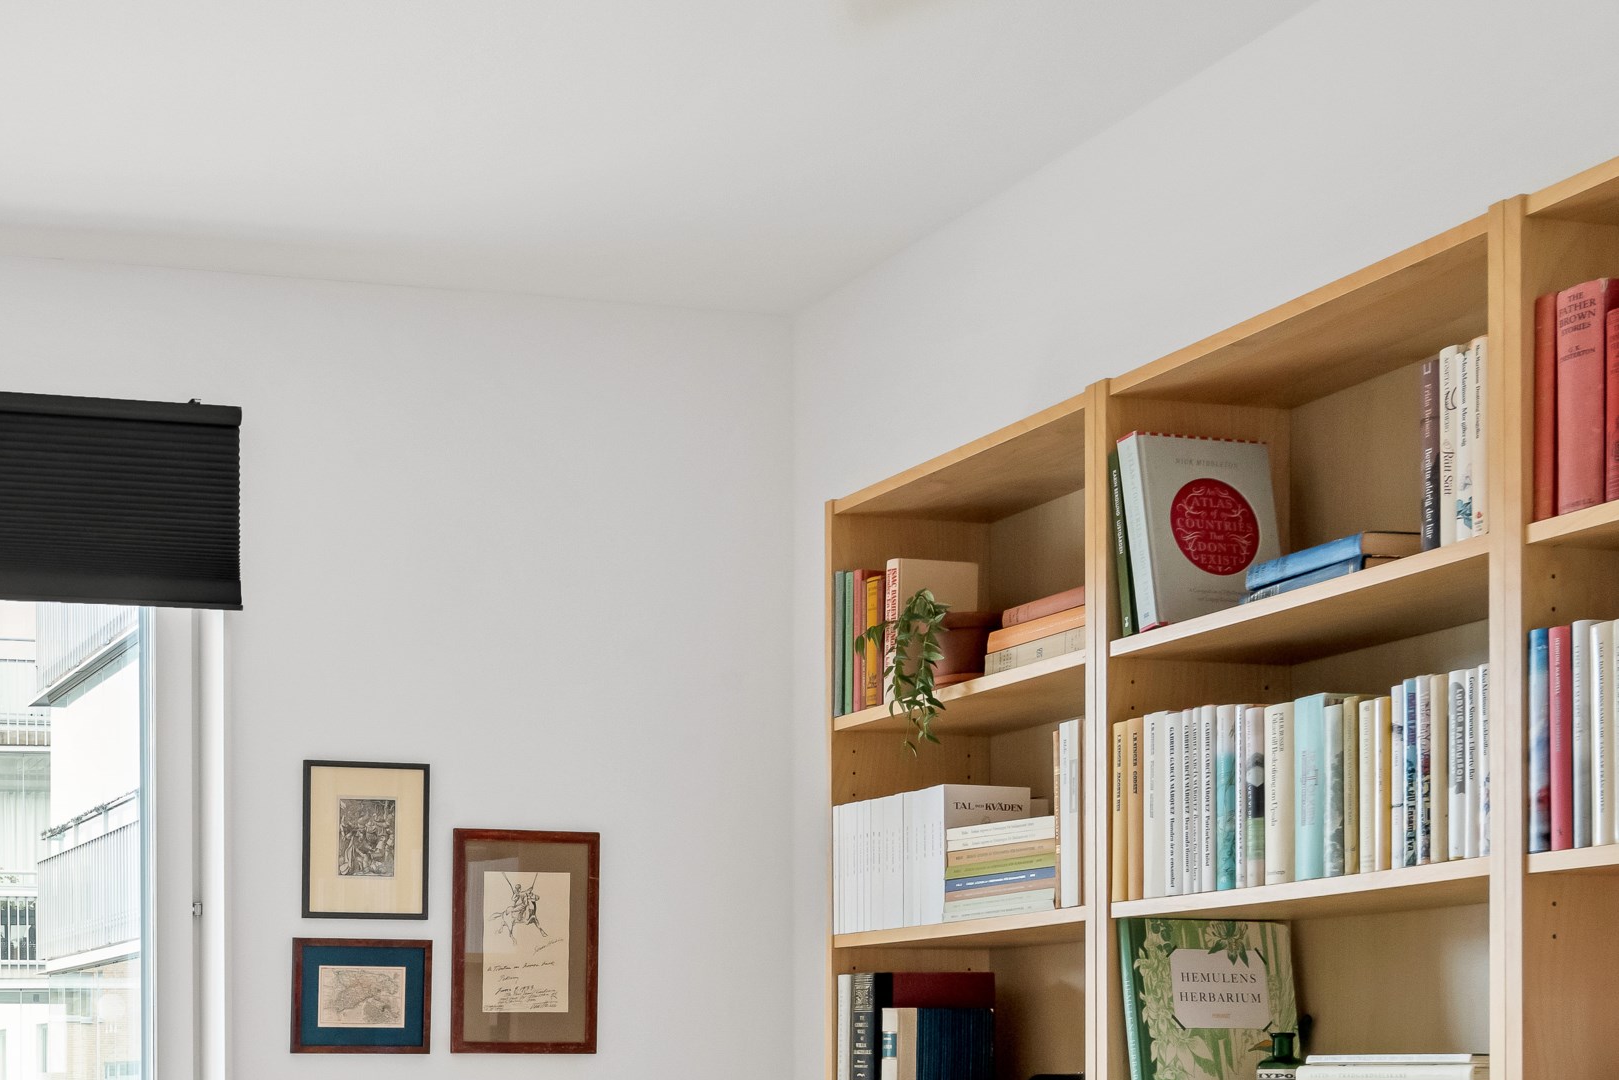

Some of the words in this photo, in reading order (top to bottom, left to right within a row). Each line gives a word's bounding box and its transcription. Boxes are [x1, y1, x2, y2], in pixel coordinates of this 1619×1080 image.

[1568, 291, 1584, 302] THE
[1559, 309, 1596, 328] BROWN
[1423, 447, 1433, 480] Berätta
[1442, 450, 1456, 473] Rätt
[1423, 480, 1433, 508] aldrig
[1442, 473, 1456, 496] Sätt
[1191, 497, 1232, 509] ATLAS
[1177, 517, 1254, 533] COUNTRIES
[1423, 508, 1433, 522] det
[1423, 522, 1433, 540] här
[1199, 542, 1239, 553] DON'T
[1200, 555, 1239, 565] EXIST
[1468, 676, 1477, 706] Georges
[1468, 705, 1477, 740] Simenon
[1168, 726, 1176, 757] GABRIEL
[1204, 721, 1212, 753] GABRIEL
[1468, 740, 1477, 768] Liberty
[1168, 756, 1176, 782] GARCÍA
[1204, 752, 1212, 779] GARCÍA
[1468, 768, 1477, 781] Bar
[1168, 782, 1176, 816] MÁRQUEZ
[1204, 780, 1212, 813] MÁRQUEZ
[1406, 789, 1417, 802] till
[953, 801, 973, 810] TAL
[985, 801, 1023, 812] KVÄDEN
[1406, 804, 1417, 833] Ensam
[1406, 836, 1417, 852] Eva
[1181, 971, 1257, 984] HEMULENS
[1179, 991, 1262, 1004] HERBARIUM
